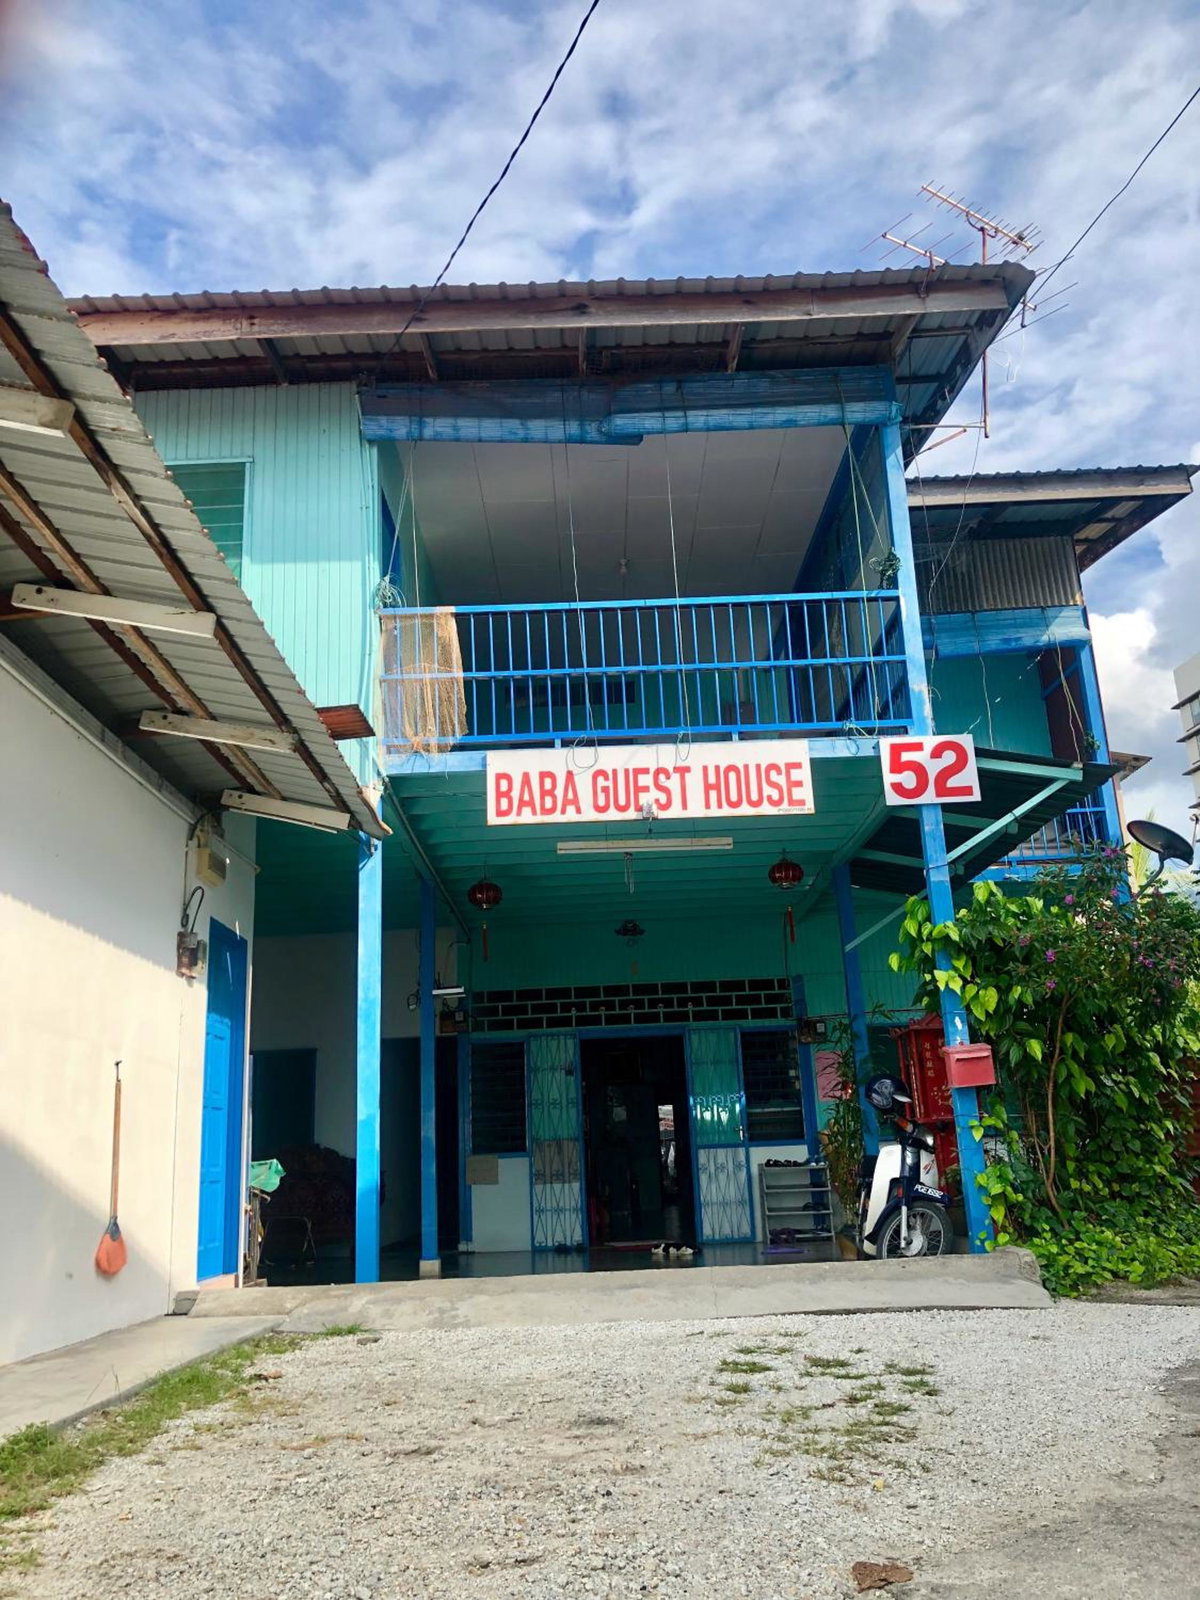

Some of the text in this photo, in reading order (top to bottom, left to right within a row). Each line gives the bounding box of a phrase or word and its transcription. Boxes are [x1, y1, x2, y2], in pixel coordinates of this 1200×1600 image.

[494, 761, 807, 818] BABA GUEST HOUSE
[888, 740, 974, 800] 52
